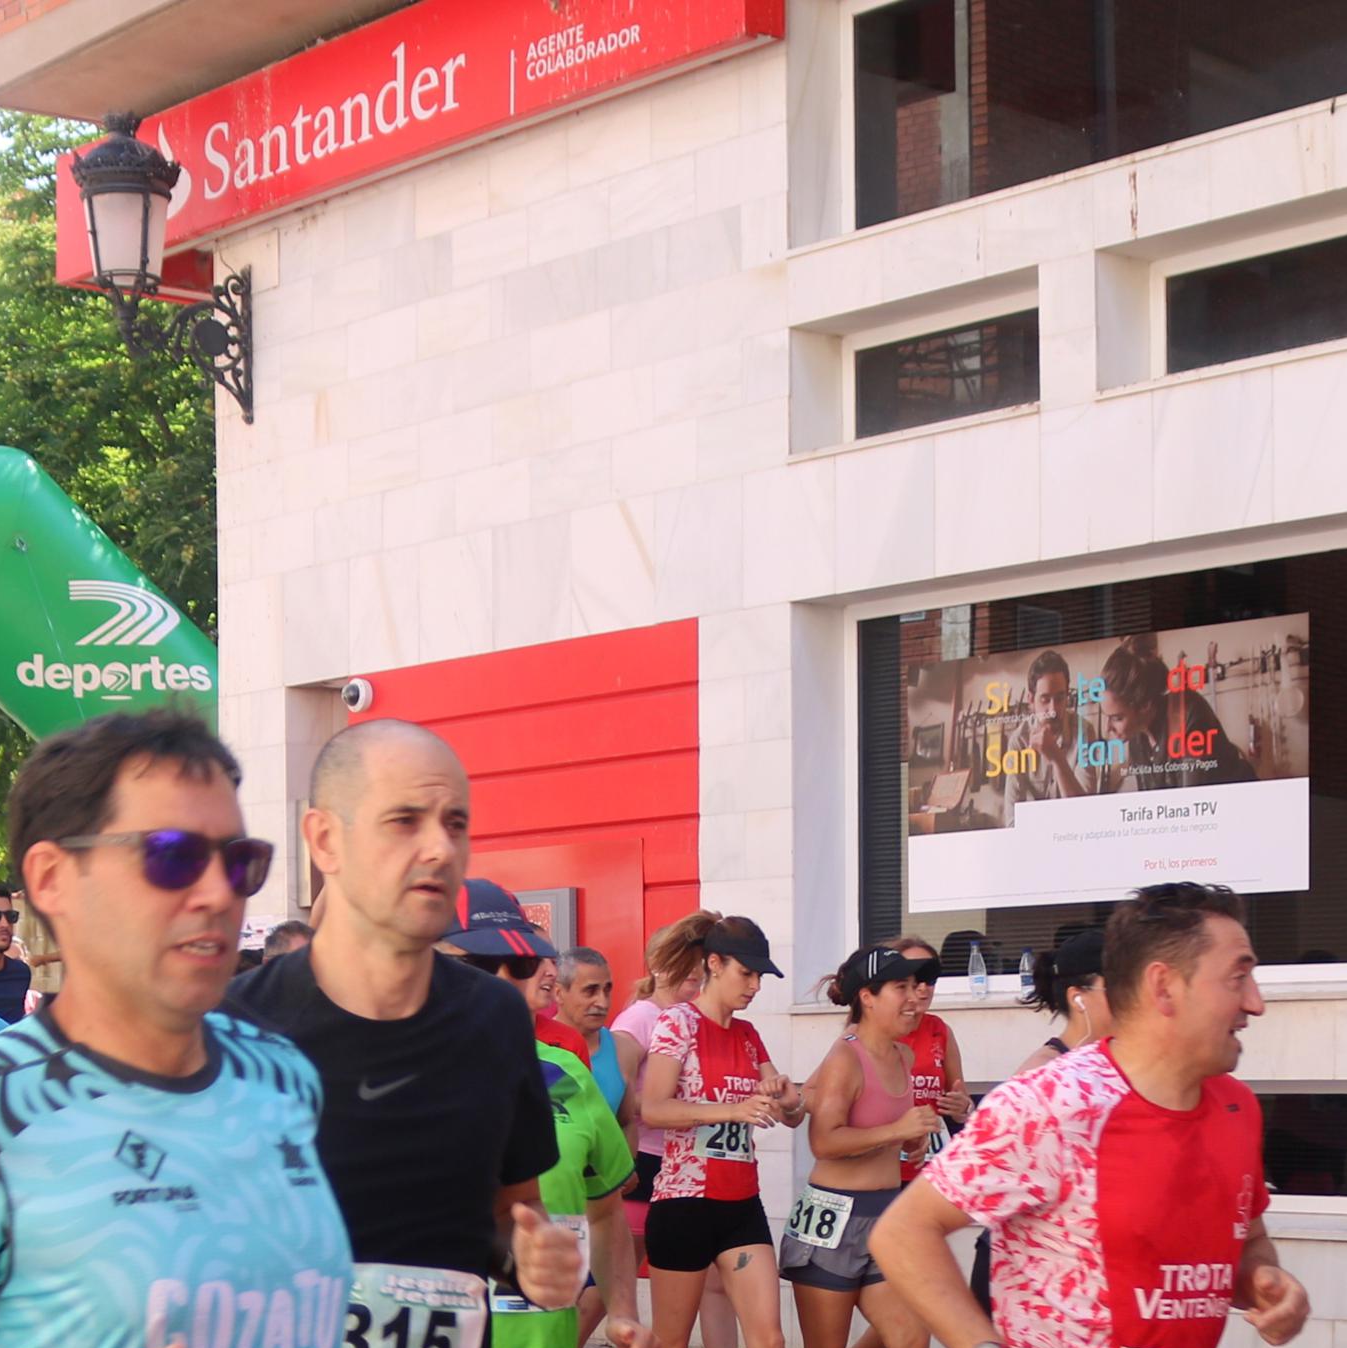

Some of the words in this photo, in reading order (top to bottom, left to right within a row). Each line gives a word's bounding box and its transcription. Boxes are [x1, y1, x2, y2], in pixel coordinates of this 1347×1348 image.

[526, 24, 584, 62] AGENTE
[526, 24, 640, 81] COLABORADOR
[203, 42, 466, 200] Santander
[16, 654, 213, 698] deportes
[985, 682, 1009, 715] Si
[1077, 671, 1106, 706] te
[1167, 660, 1205, 694] da
[985, 743, 1037, 778] San
[1077, 735, 1125, 769] tan
[1167, 724, 1218, 758] der
[1165, 761, 1189, 772] Cobros
[1195, 759, 1218, 771] Pagos
[1120, 807, 1152, 822] Tarifa
[1157, 805, 1189, 820] Plana
[1193, 801, 1218, 816] TPV
[1144, 859, 1157, 870] Por
[1168, 857, 1180, 869] los
[1181, 856, 1217, 872] primeros
[790, 1200, 837, 1240] 318
[1159, 1263, 1233, 1292] TROTA
